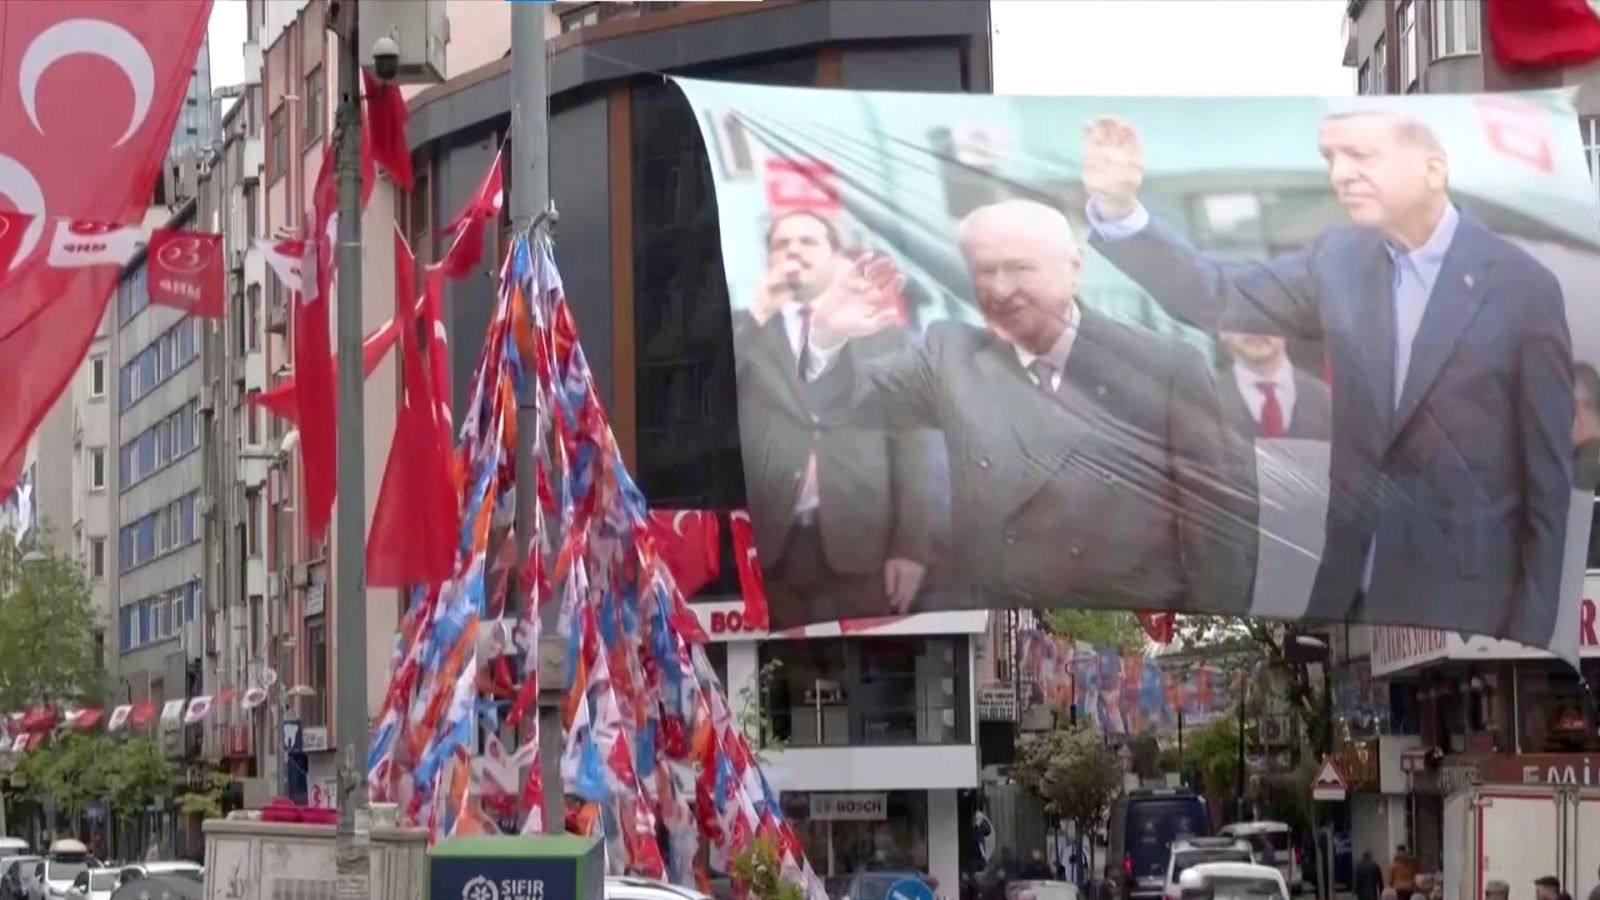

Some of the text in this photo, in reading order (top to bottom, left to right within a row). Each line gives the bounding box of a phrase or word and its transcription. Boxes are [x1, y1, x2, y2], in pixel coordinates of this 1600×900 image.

[711, 610, 755, 633] BO
[836, 801, 882, 813] BOSCH
[501, 880, 544, 895] SIFIR
